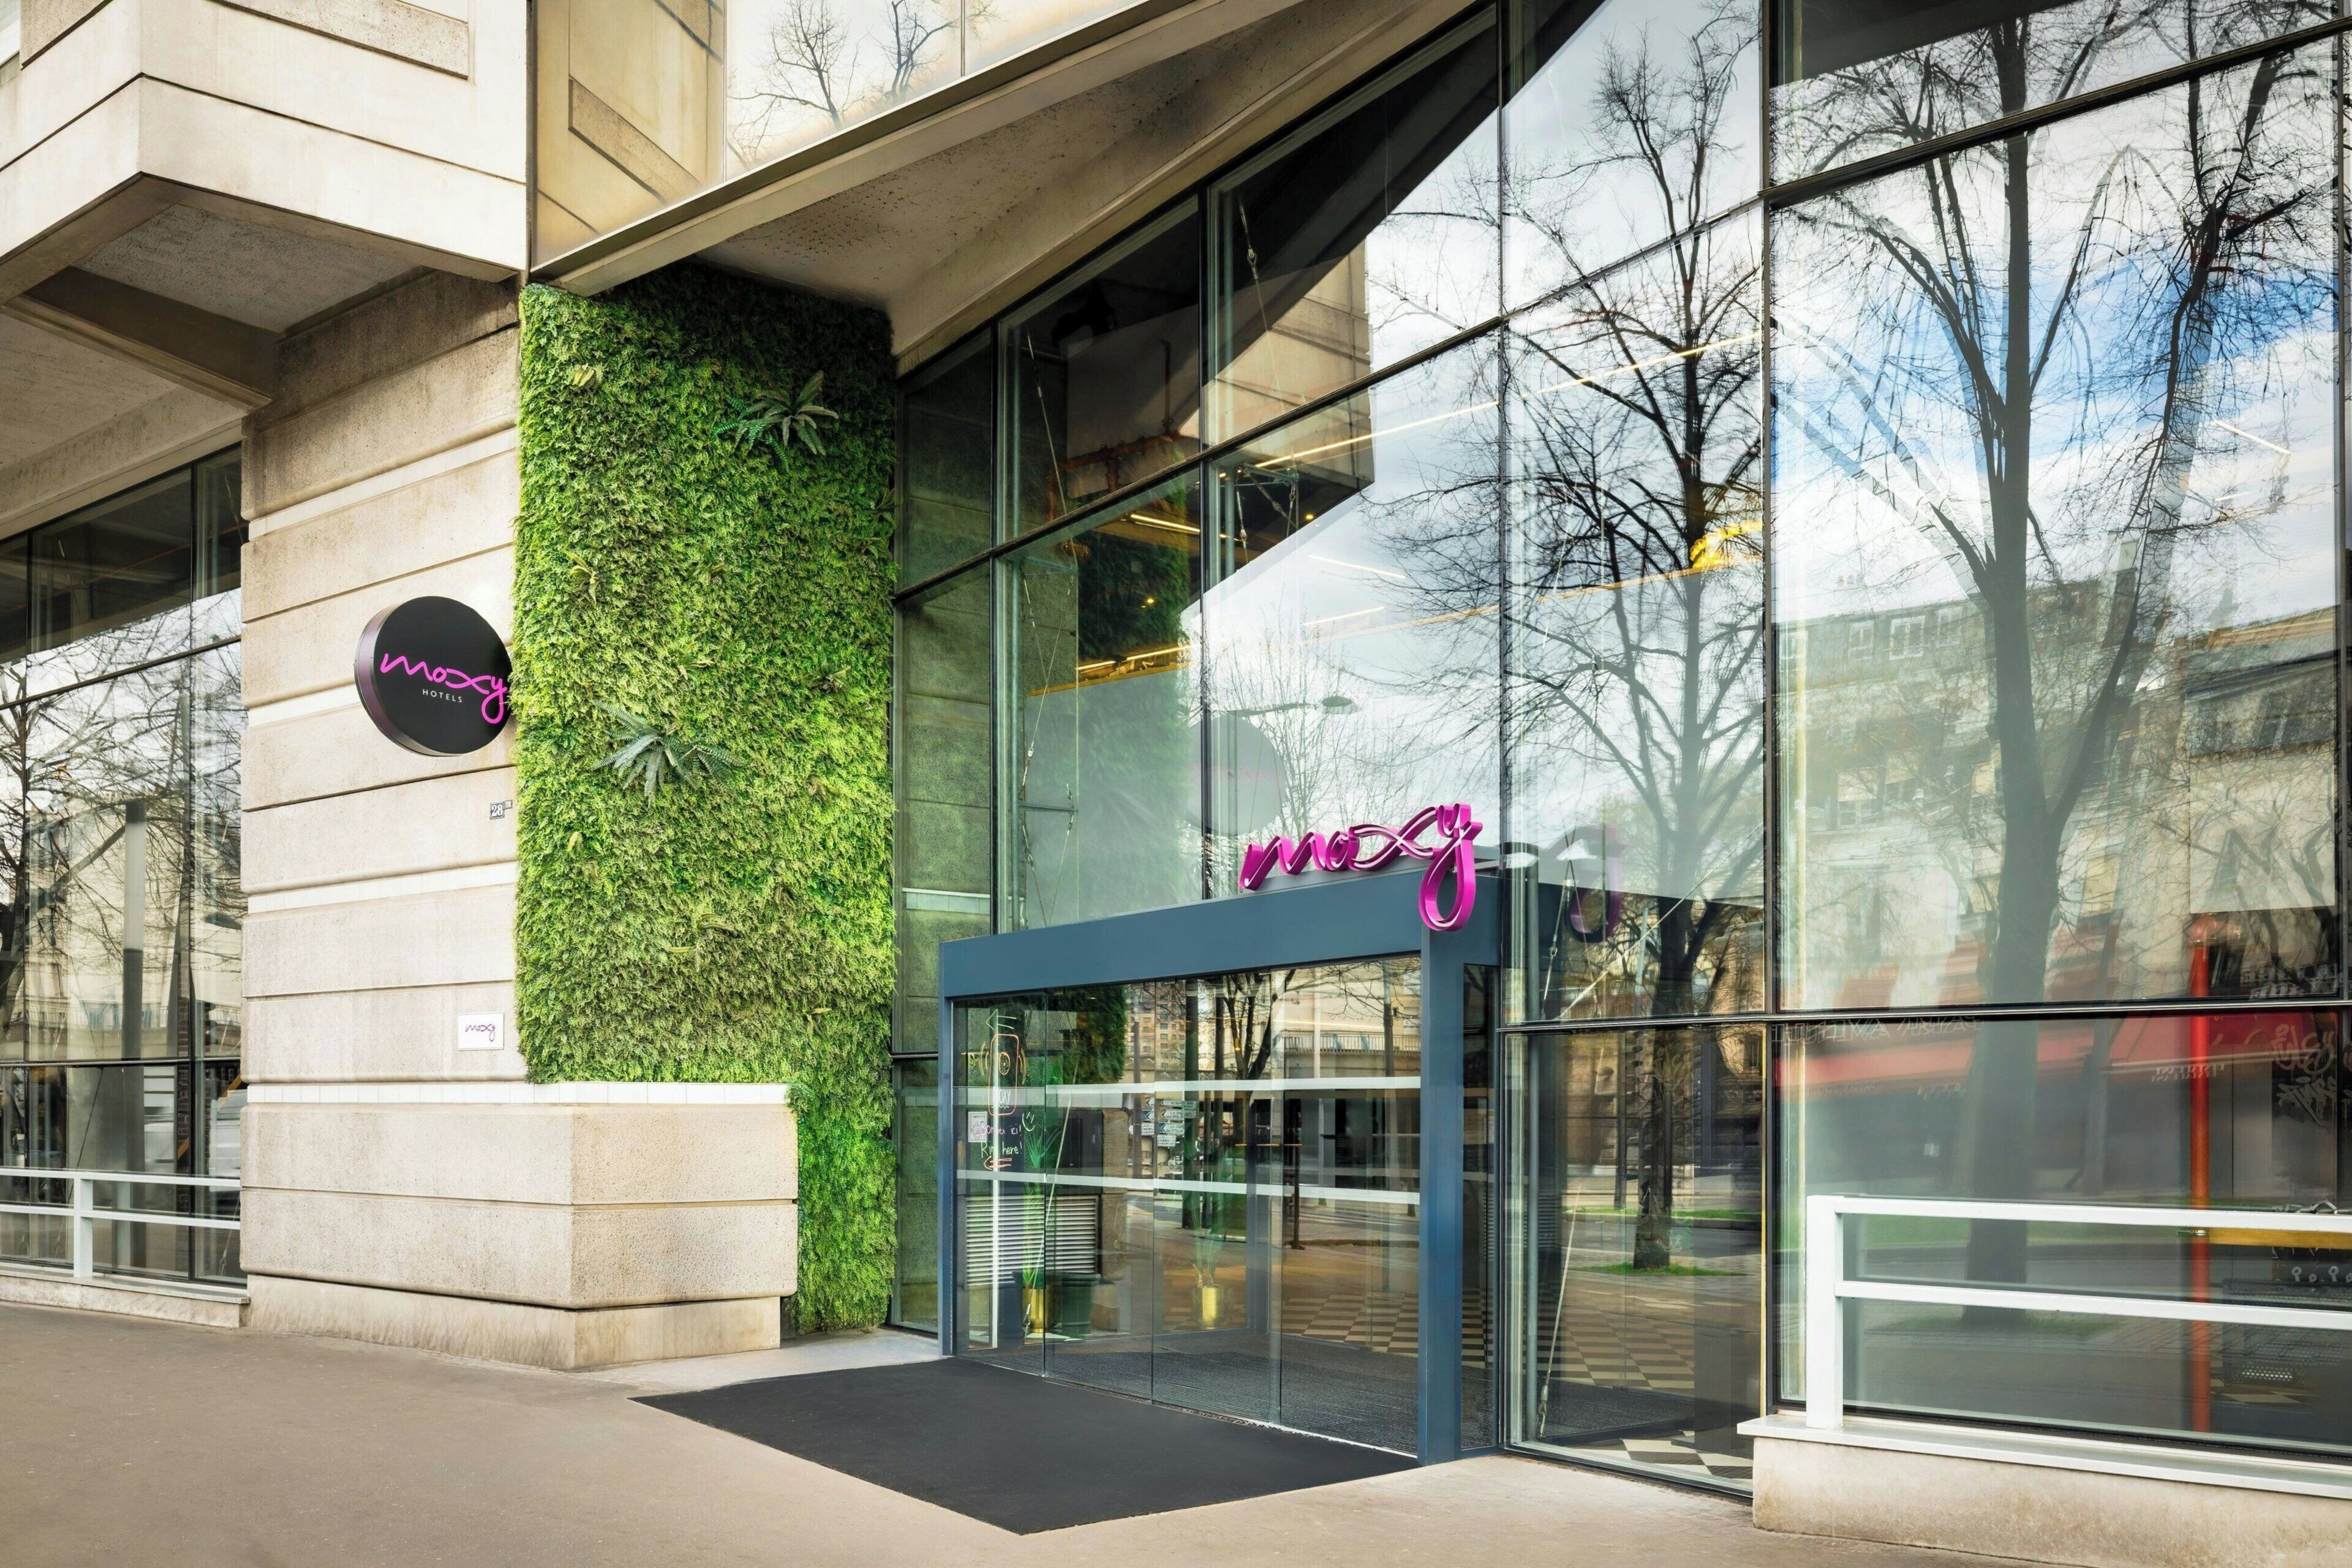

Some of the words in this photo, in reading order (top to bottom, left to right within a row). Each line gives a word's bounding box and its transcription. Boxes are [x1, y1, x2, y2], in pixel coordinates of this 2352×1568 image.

[380, 653, 508, 724] moxy
[422, 688, 462, 703] HOTELS
[491, 804, 503, 816] 28
[1240, 802, 1483, 932] moxy
[465, 1023, 496, 1042] moxy
[993, 1089, 1011, 1105] OXY
